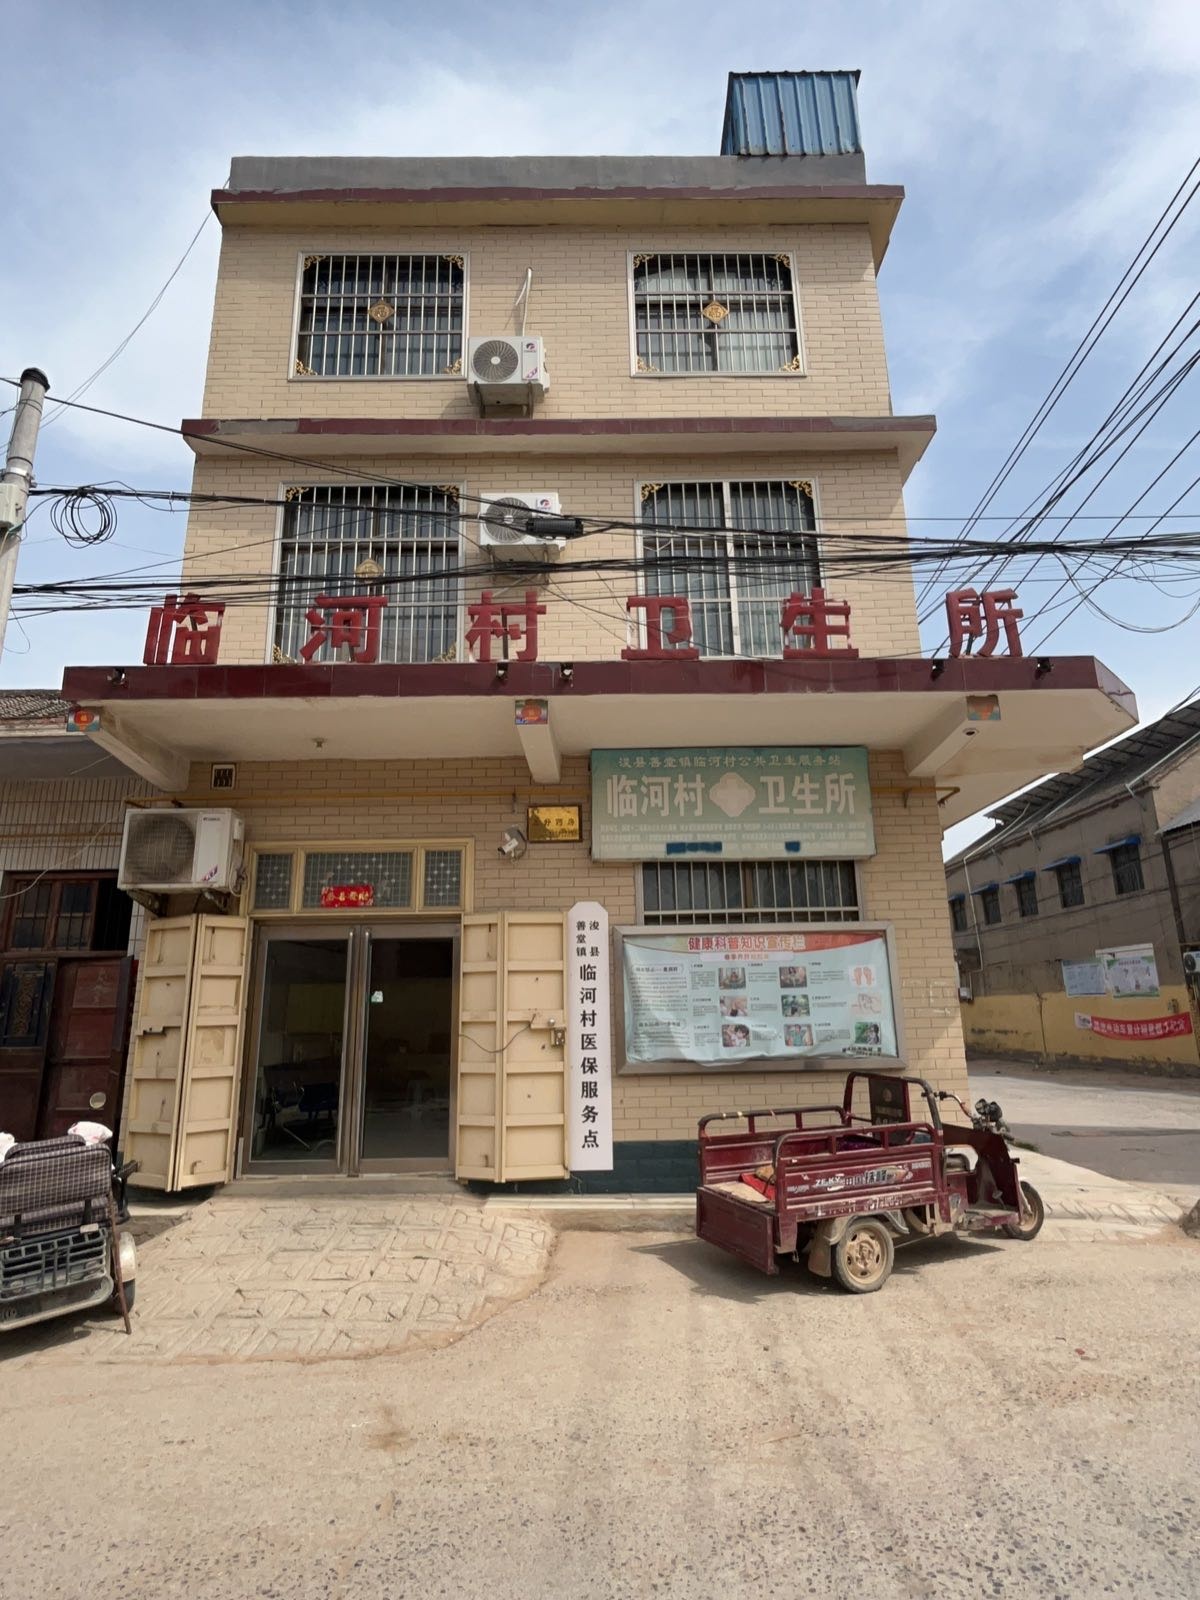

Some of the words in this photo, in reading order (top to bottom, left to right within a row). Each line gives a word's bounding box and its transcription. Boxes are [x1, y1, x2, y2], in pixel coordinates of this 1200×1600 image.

[143, 587, 1024, 665] 临河村卫生所
[606, 773, 705, 817] 临河村
[758, 772, 857, 816] 卫生所
[576, 920, 587, 957] 善堂镇
[688, 934, 806, 951] 健康科普知识宣传栏
[580, 963, 599, 1148] 临河村医保服务点
